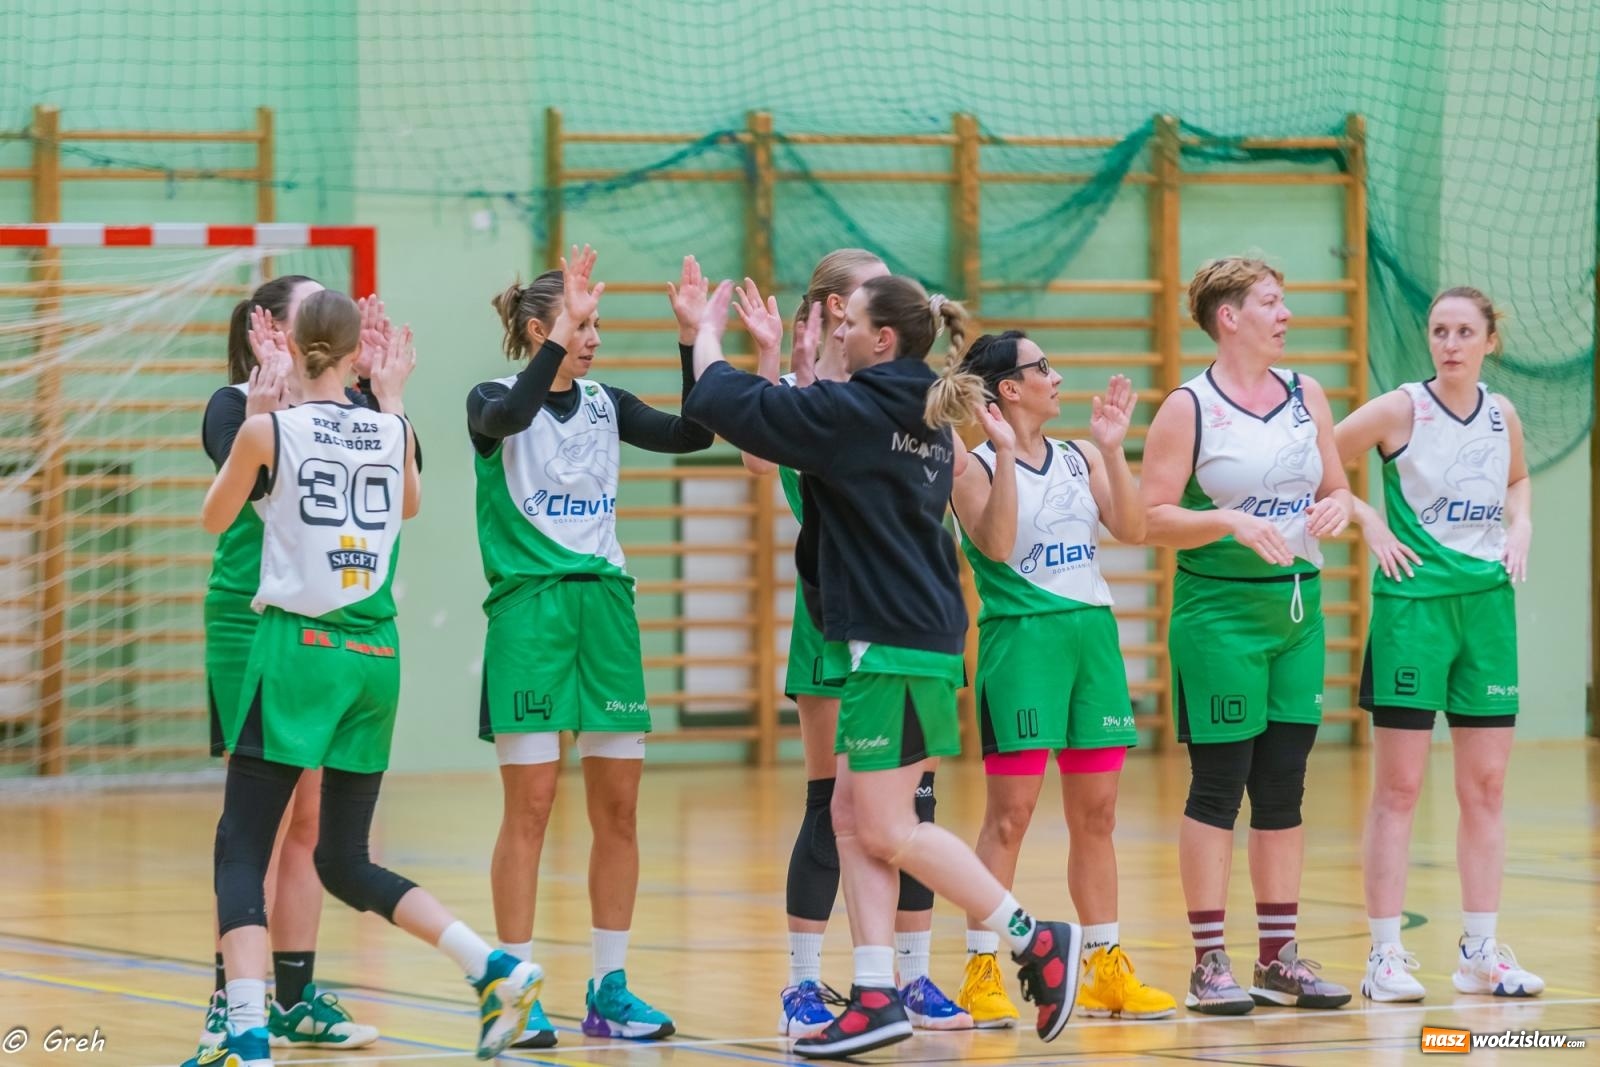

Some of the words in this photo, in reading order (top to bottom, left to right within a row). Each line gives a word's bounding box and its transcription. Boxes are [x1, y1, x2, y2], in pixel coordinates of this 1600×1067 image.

[352, 422, 378, 433] AZS
[584, 402, 610, 424] 14
[298, 458, 399, 530] 30
[331, 552, 376, 568] SEGET
[1395, 666, 1420, 696] 9
[514, 690, 552, 721] 14
[1211, 694, 1247, 724] 10
[1017, 708, 1038, 738] 11
